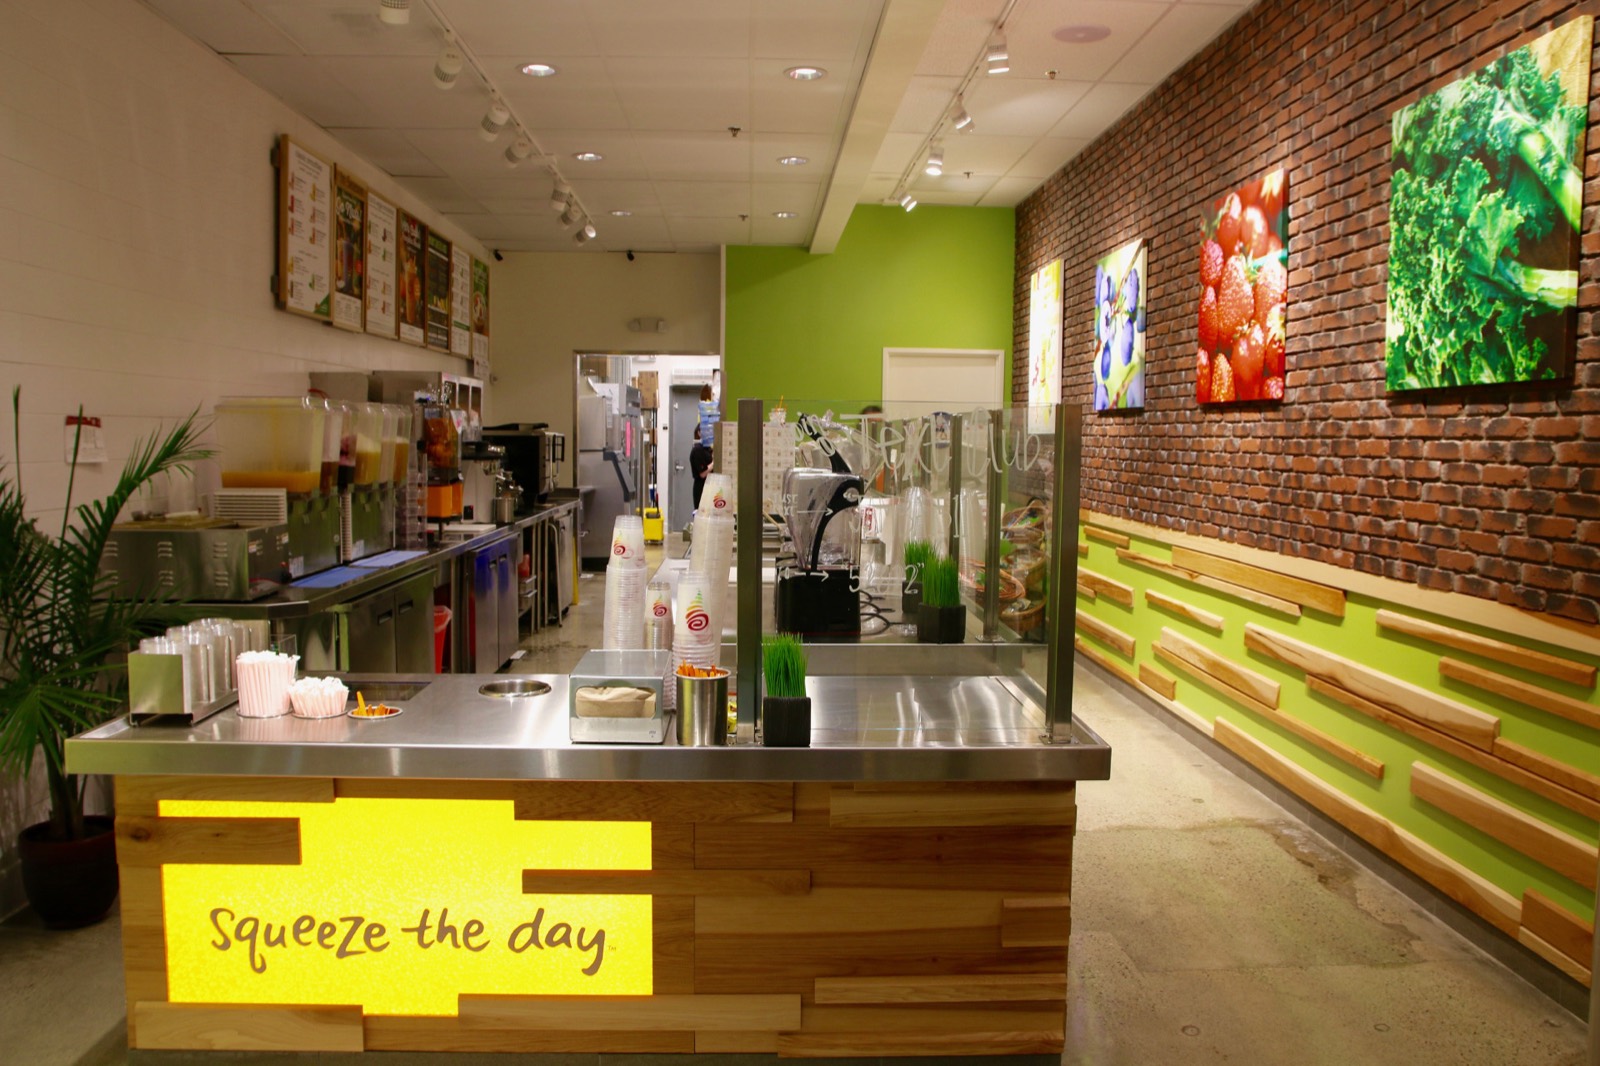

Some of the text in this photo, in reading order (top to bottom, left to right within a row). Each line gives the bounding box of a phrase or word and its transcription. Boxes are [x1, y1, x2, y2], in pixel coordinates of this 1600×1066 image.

[839, 413, 952, 480] Text
[966, 406, 1041, 478] Club
[400, 907, 490, 952] the
[507, 907, 606, 976] day
